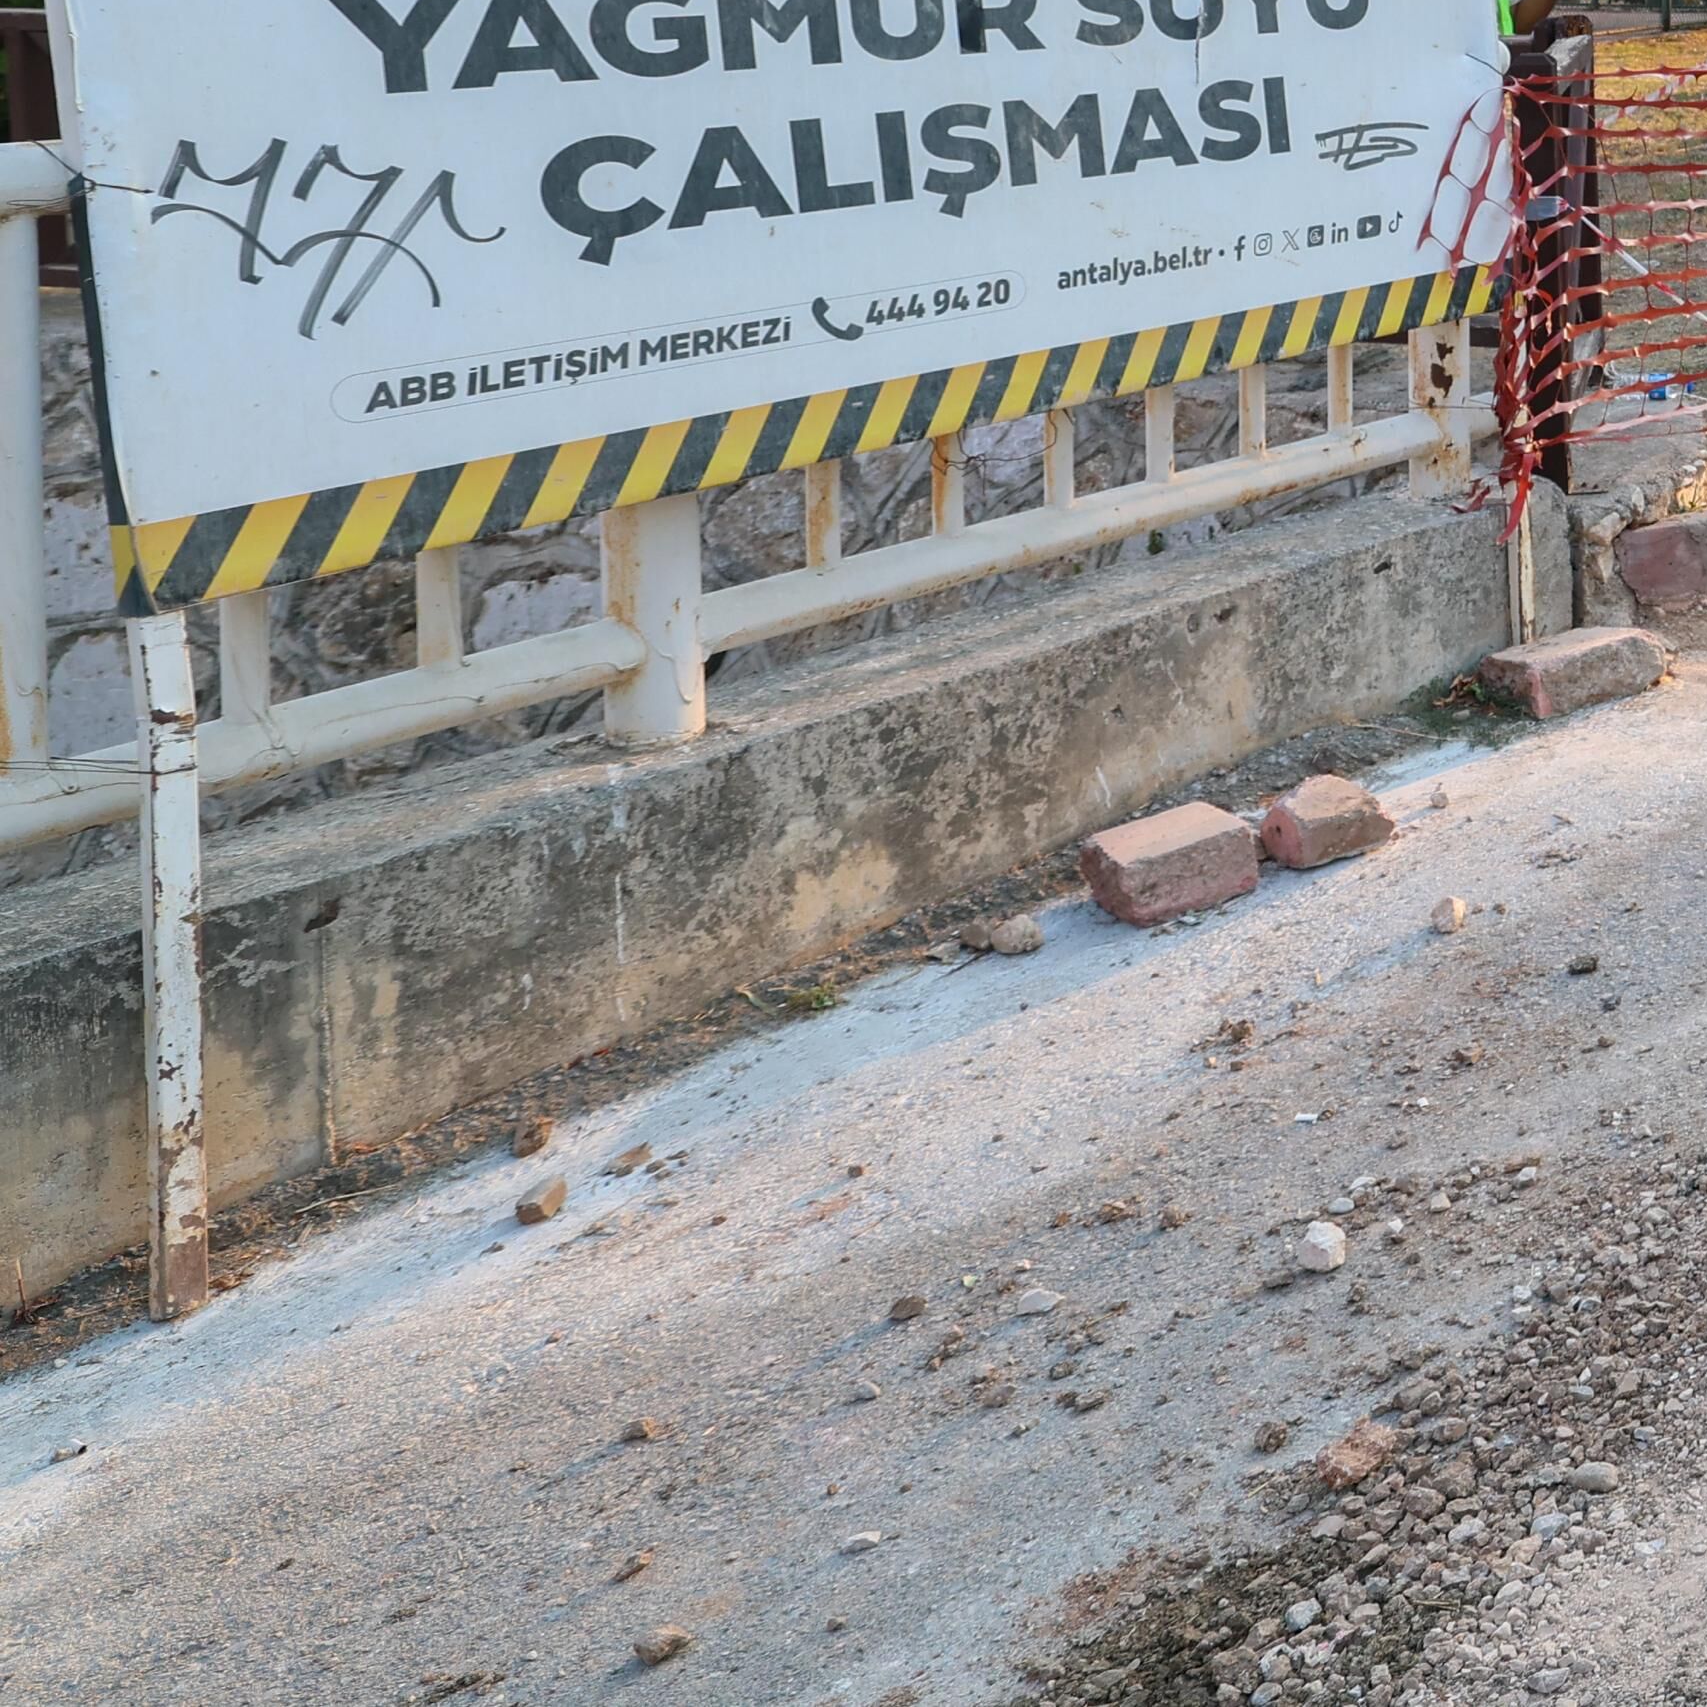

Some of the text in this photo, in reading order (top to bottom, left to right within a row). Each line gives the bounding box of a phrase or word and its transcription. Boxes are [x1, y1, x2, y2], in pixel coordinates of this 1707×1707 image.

[539, 76, 1293, 266] ÇALIŞMASI
[1057, 245, 1213, 290] antalya.bel.tr
[364, 279, 1010, 414] ABB İLETİŞİM MERKEZİ 444 94 20
